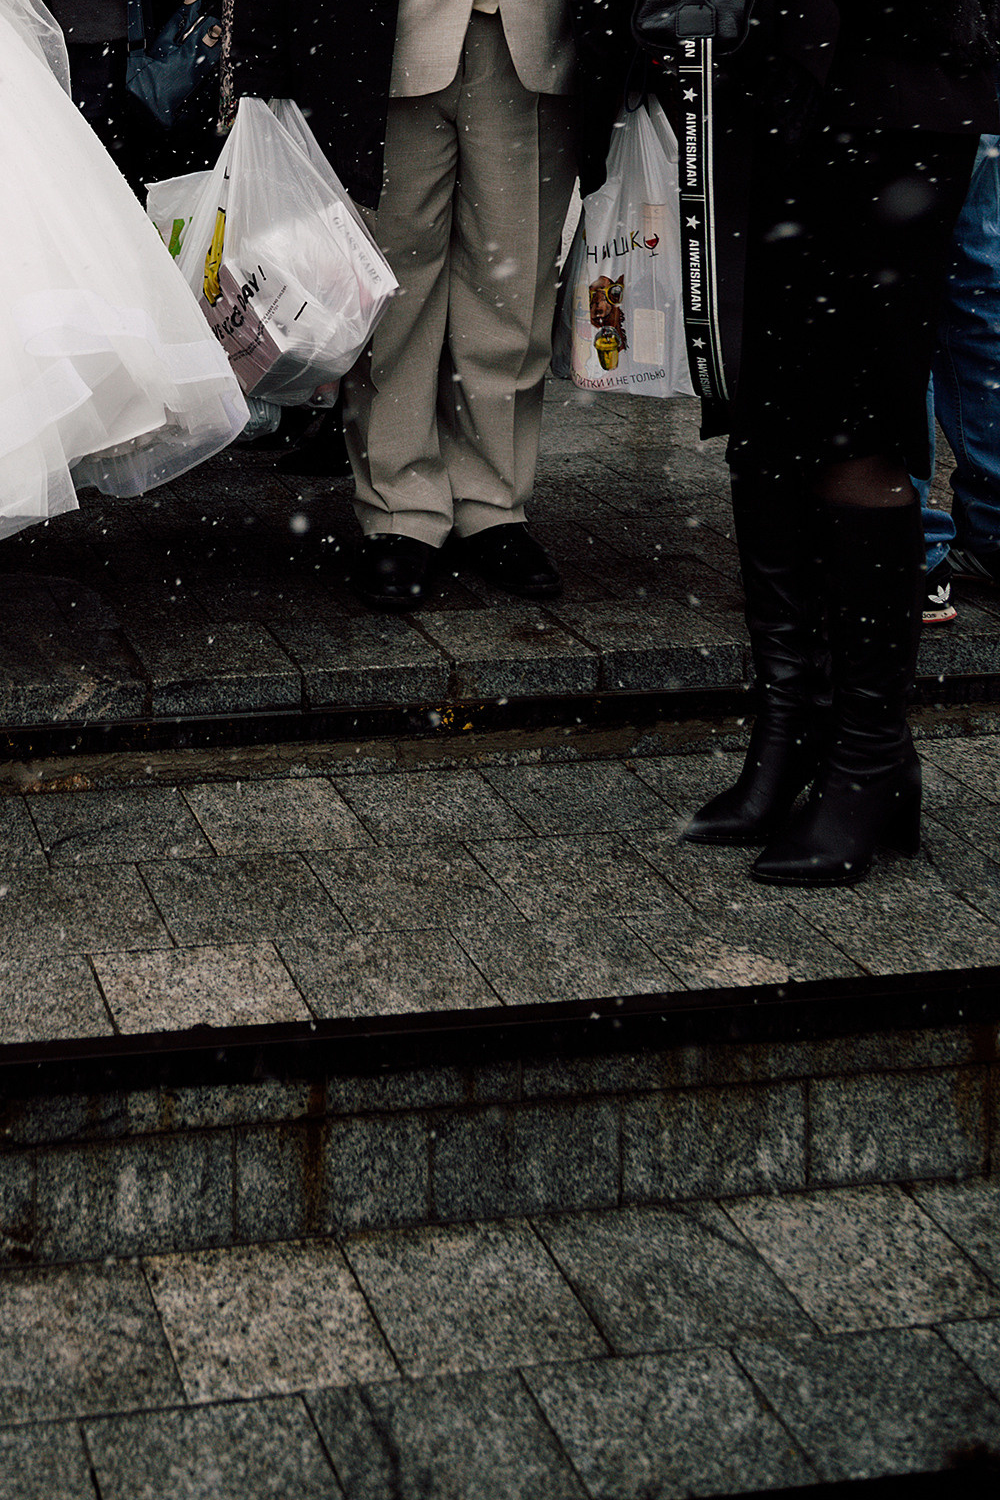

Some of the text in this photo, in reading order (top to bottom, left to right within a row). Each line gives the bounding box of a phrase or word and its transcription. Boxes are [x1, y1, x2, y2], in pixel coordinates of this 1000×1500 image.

[685, 112, 698, 187] AIWEISIMAN
[688, 239, 703, 312] AIWEISIMAN
[571, 368, 666, 388] ПИТКИ И НЕ ТОЛЬКО
